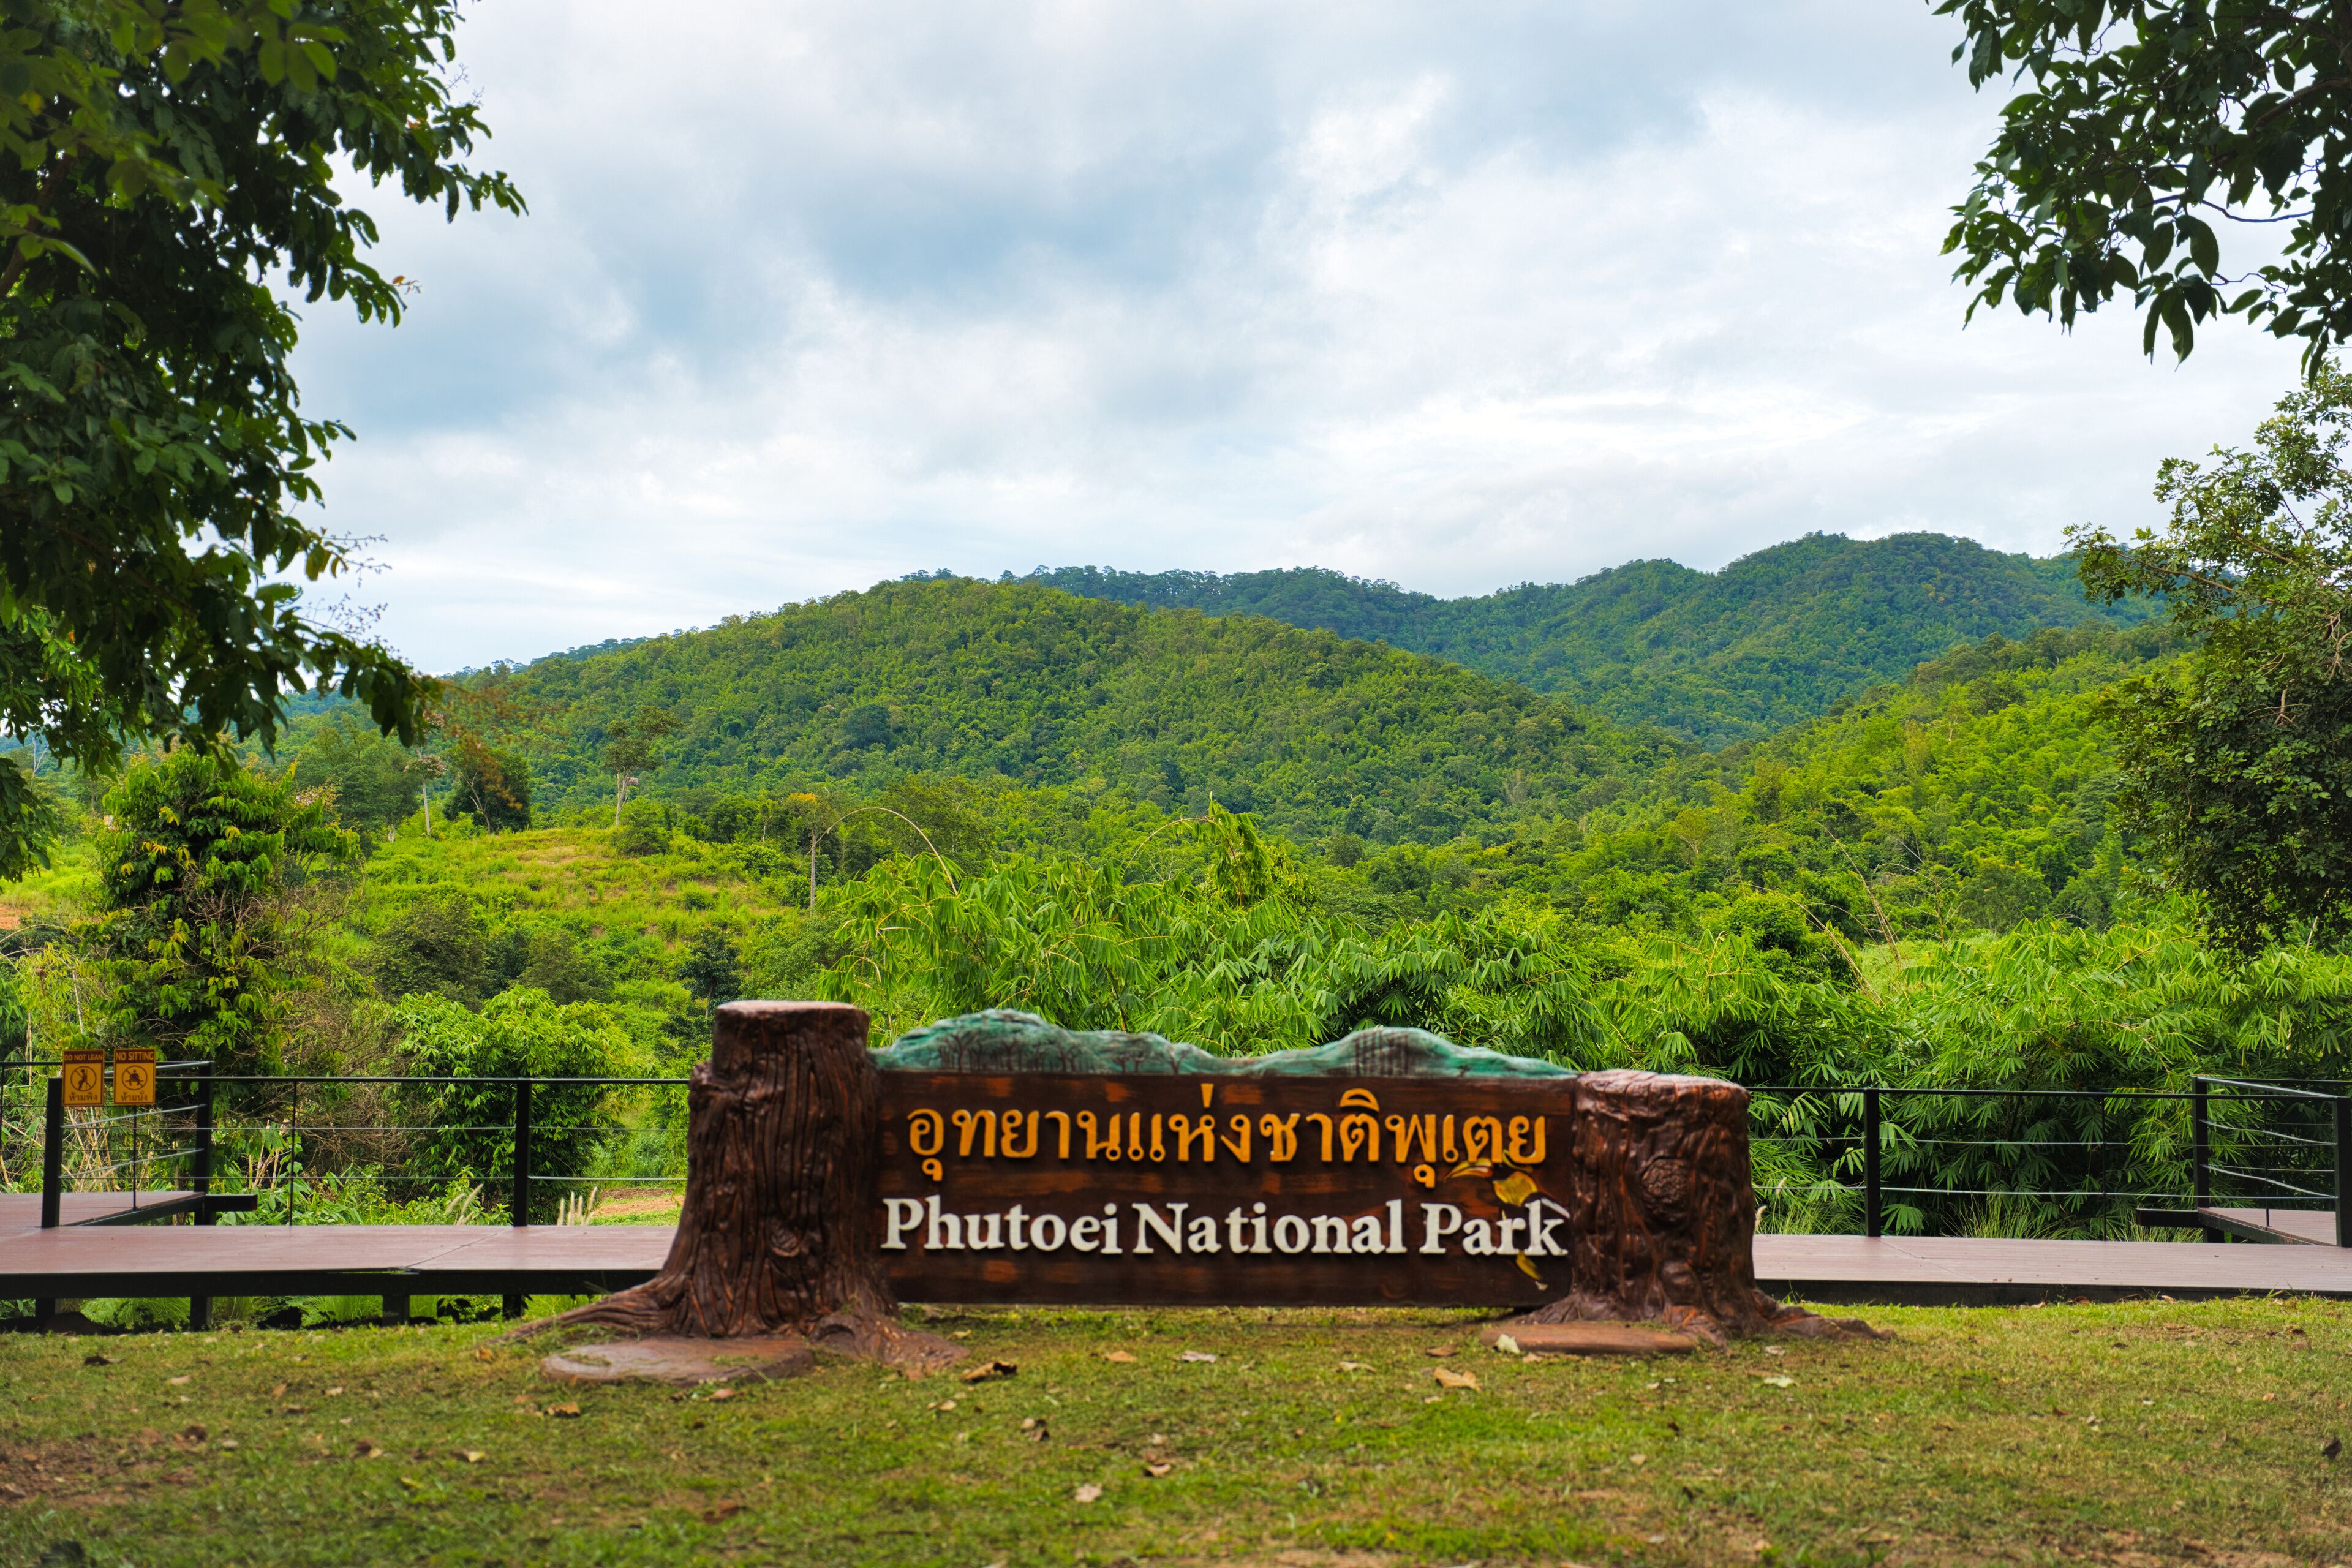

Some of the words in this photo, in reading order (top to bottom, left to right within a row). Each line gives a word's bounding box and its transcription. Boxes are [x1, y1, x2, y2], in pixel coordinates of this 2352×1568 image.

[116, 1052, 126, 1061] NO
[128, 1052, 154, 1061] SITTING
[121, 1090, 148, 1101] ห้ามนั่ง
[907, 1084, 1546, 1189] อุทยานแห่งชาติพุเตย
[880, 1194, 1123, 1254] Phutoei
[1131, 1198, 1408, 1255] National
[1419, 1198, 1569, 1256] Park
